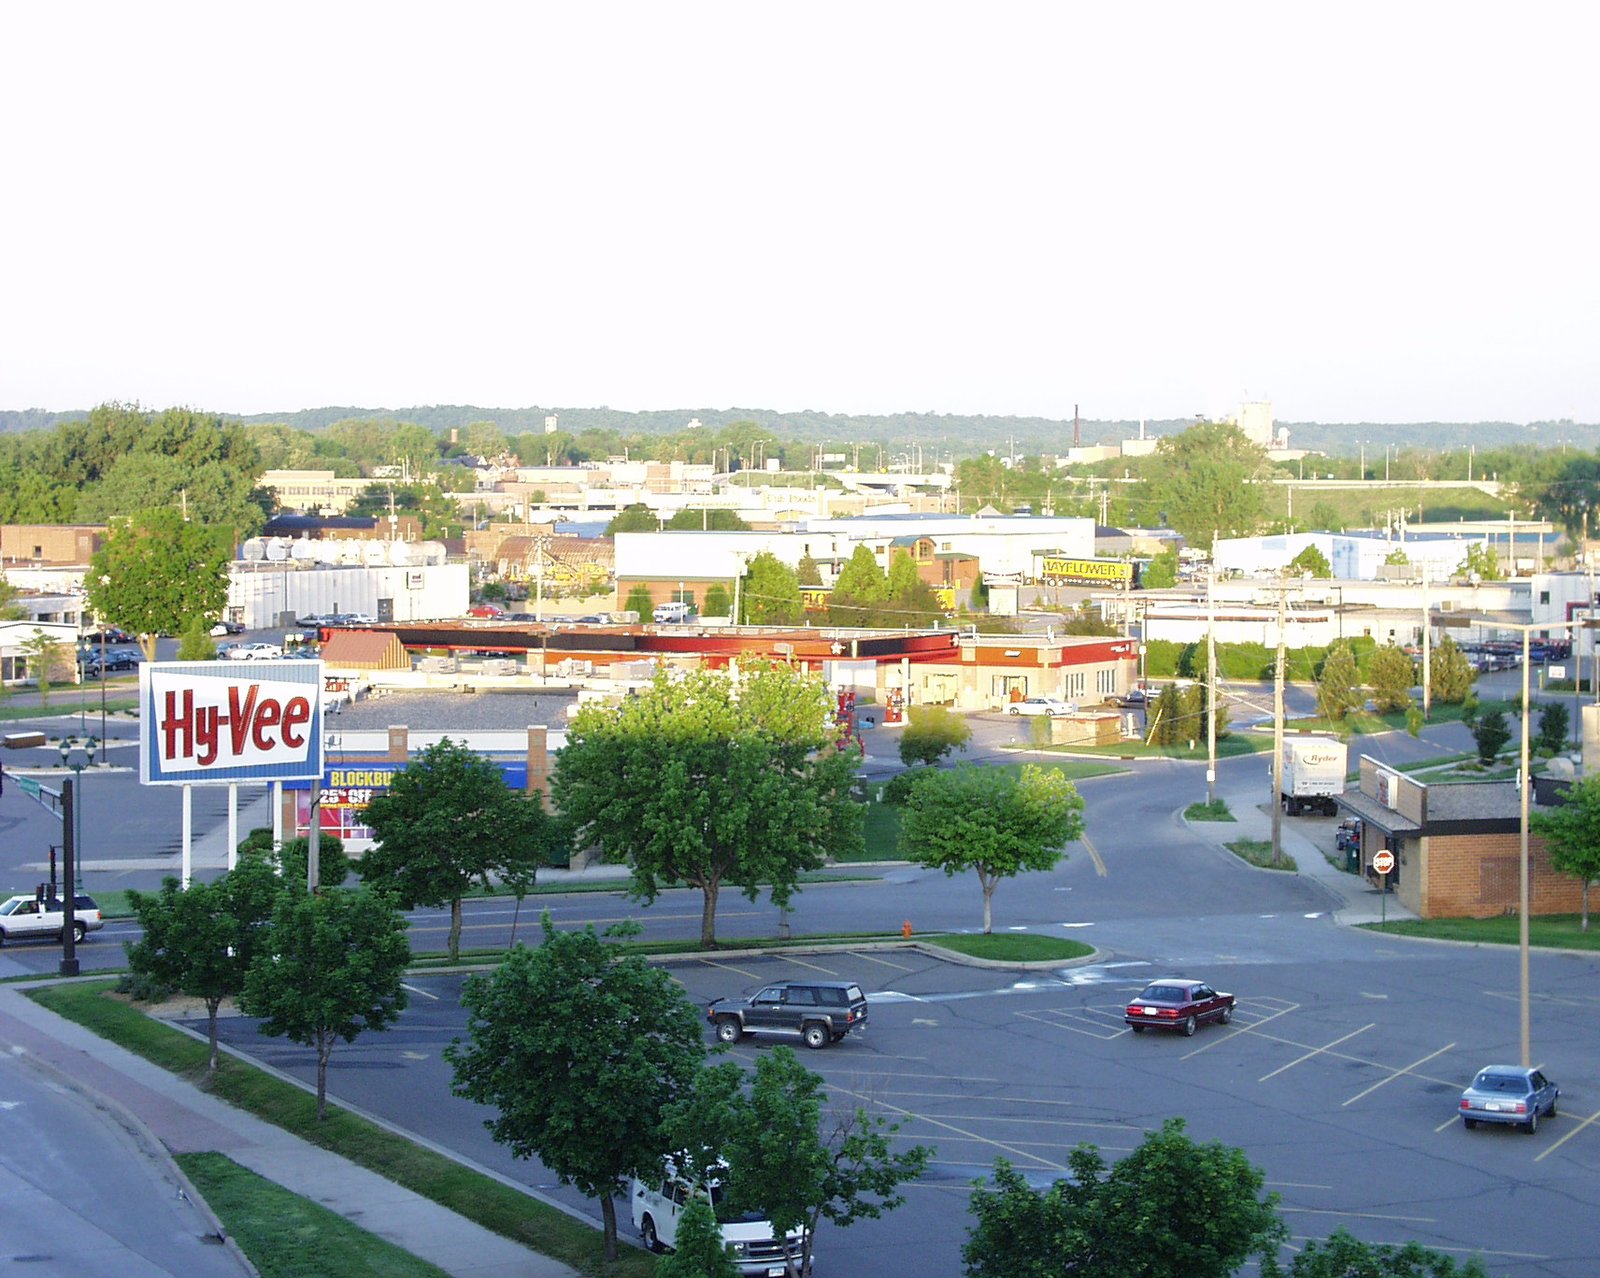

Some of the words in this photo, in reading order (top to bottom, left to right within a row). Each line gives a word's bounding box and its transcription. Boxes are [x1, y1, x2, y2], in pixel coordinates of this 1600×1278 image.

[1043, 561, 1116, 576] MAYFLOWER
[162, 684, 310, 766] Hy-Vee
[1311, 754, 1338, 763] Ryder
[331, 771, 392, 786] BLOCKBU
[348, 789, 372, 803] OFF
[1375, 857, 1392, 867] STOP
